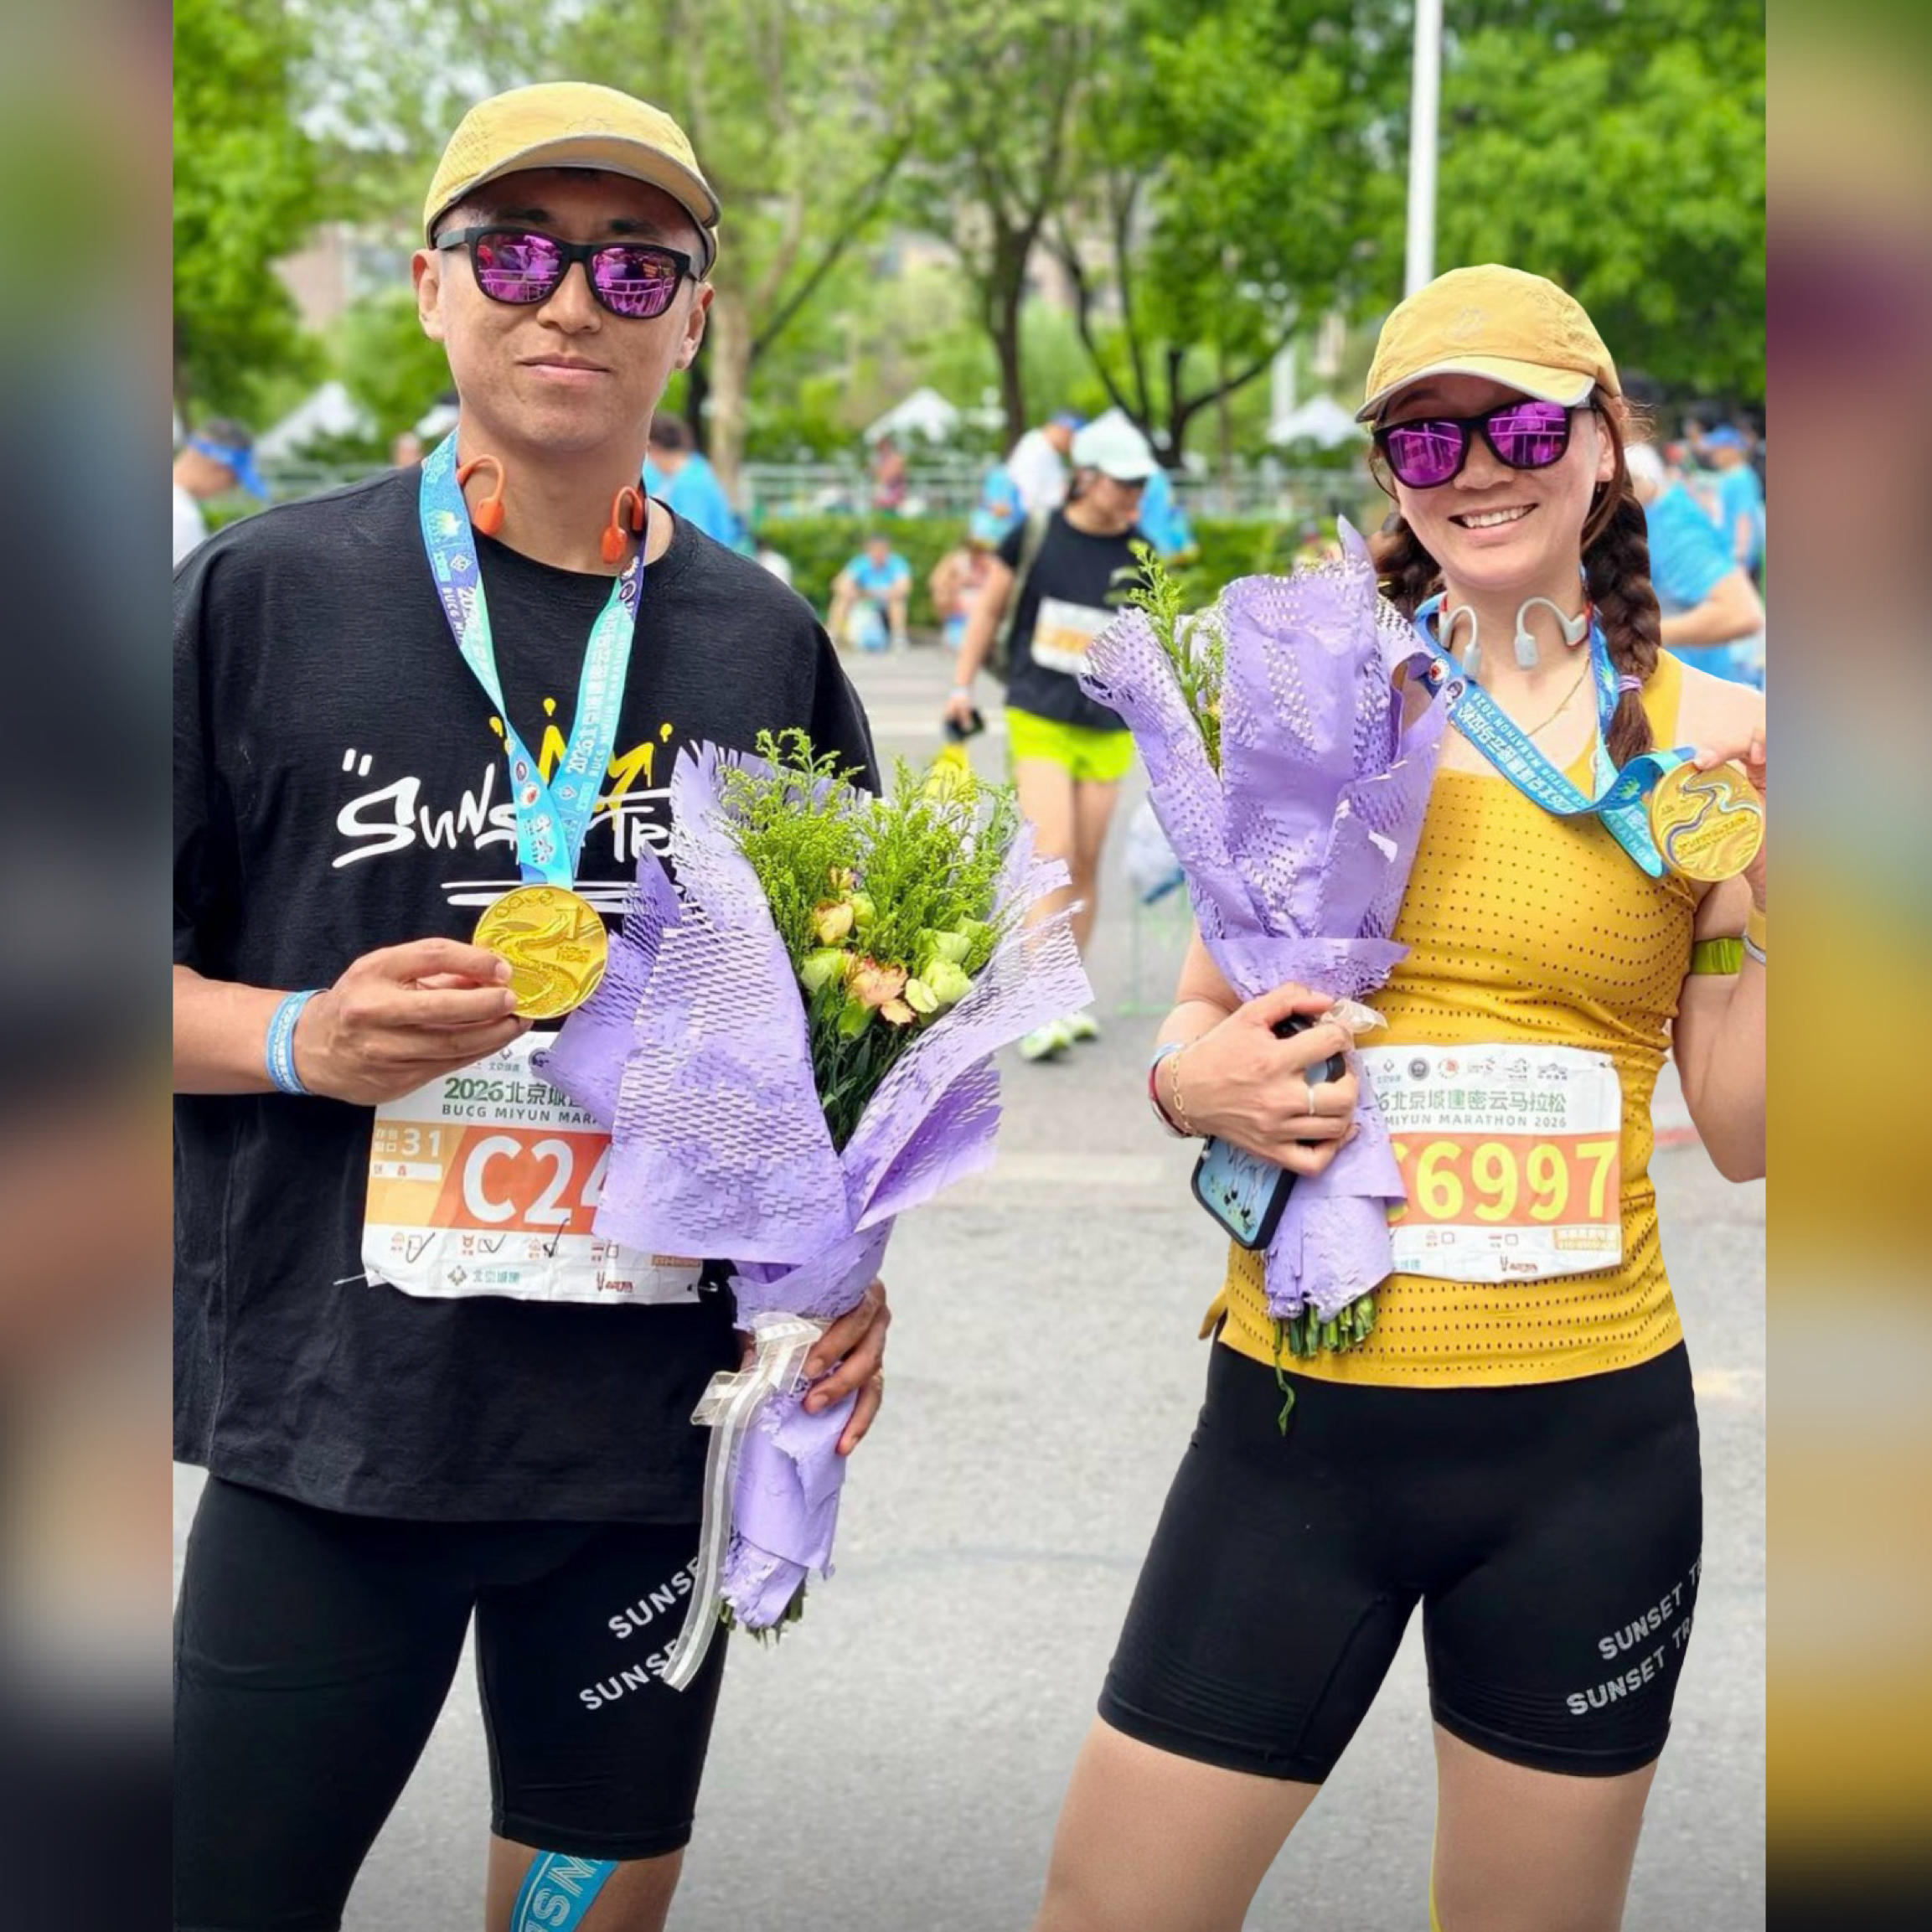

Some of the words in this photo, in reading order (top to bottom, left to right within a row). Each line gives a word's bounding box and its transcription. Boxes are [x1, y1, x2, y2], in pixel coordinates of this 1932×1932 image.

[444, 1077, 580, 1108] 2026北京城
[442, 1103, 487, 1118] BUCG
[495, 1107, 550, 1122] MIYUN
[1384, 1113, 1431, 1127] MIYUN
[1439, 1114, 1526, 1127] MARATHON
[1534, 1116, 1567, 1129] 2026
[401, 1127, 441, 1157] 31
[1598, 1582, 1683, 1660] SUNSET
[1566, 1645, 1666, 1716] SUNSET
